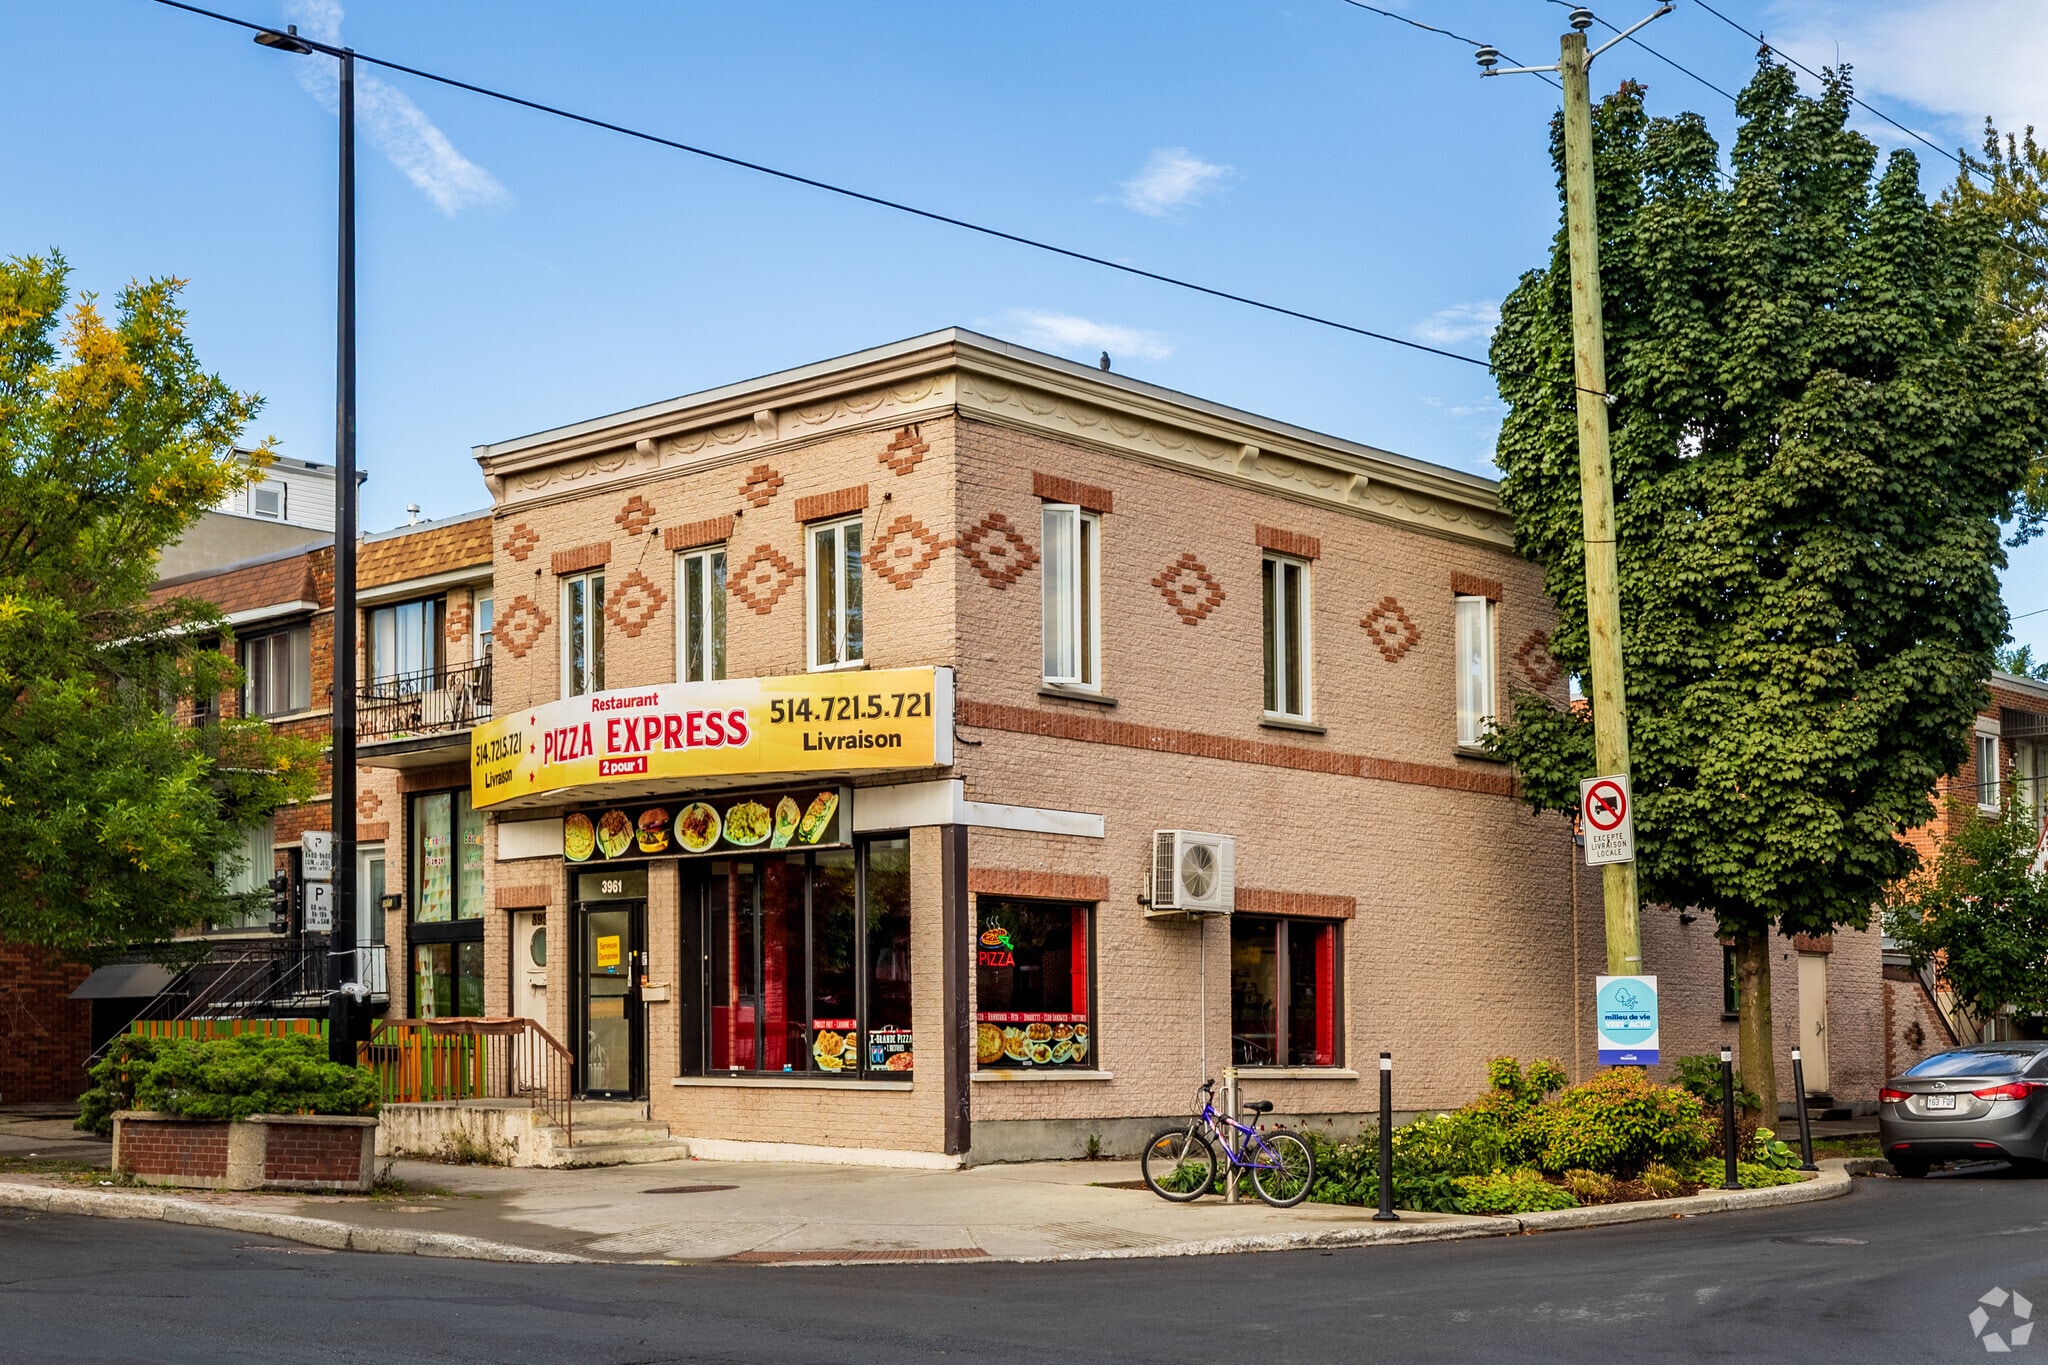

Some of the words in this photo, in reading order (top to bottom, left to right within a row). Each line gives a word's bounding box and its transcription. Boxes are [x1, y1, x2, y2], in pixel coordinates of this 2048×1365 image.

[591, 692, 660, 712] Restaurant
[770, 691, 932, 724] 514.721.5.721
[542, 721, 595, 767] PIZZA
[605, 709, 750, 754] EXPRESS
[802, 729, 902, 752] Livraison
[475, 730, 523, 767] 514.721.5.721
[602, 760, 610, 774] 2
[610, 760, 635, 776] pour
[636, 757, 644, 772] 1
[484, 767, 513, 789] Livraison
[1591, 840, 1627, 851] LIVRAISON
[1597, 848, 1623, 858] LOCALE
[315, 887, 324, 901] P
[601, 879, 623, 894] 3961
[978, 951, 1016, 967] PIZZA
[869, 1034, 896, 1044] X-GRANDE
[897, 1033, 913, 1044] PIZZA
